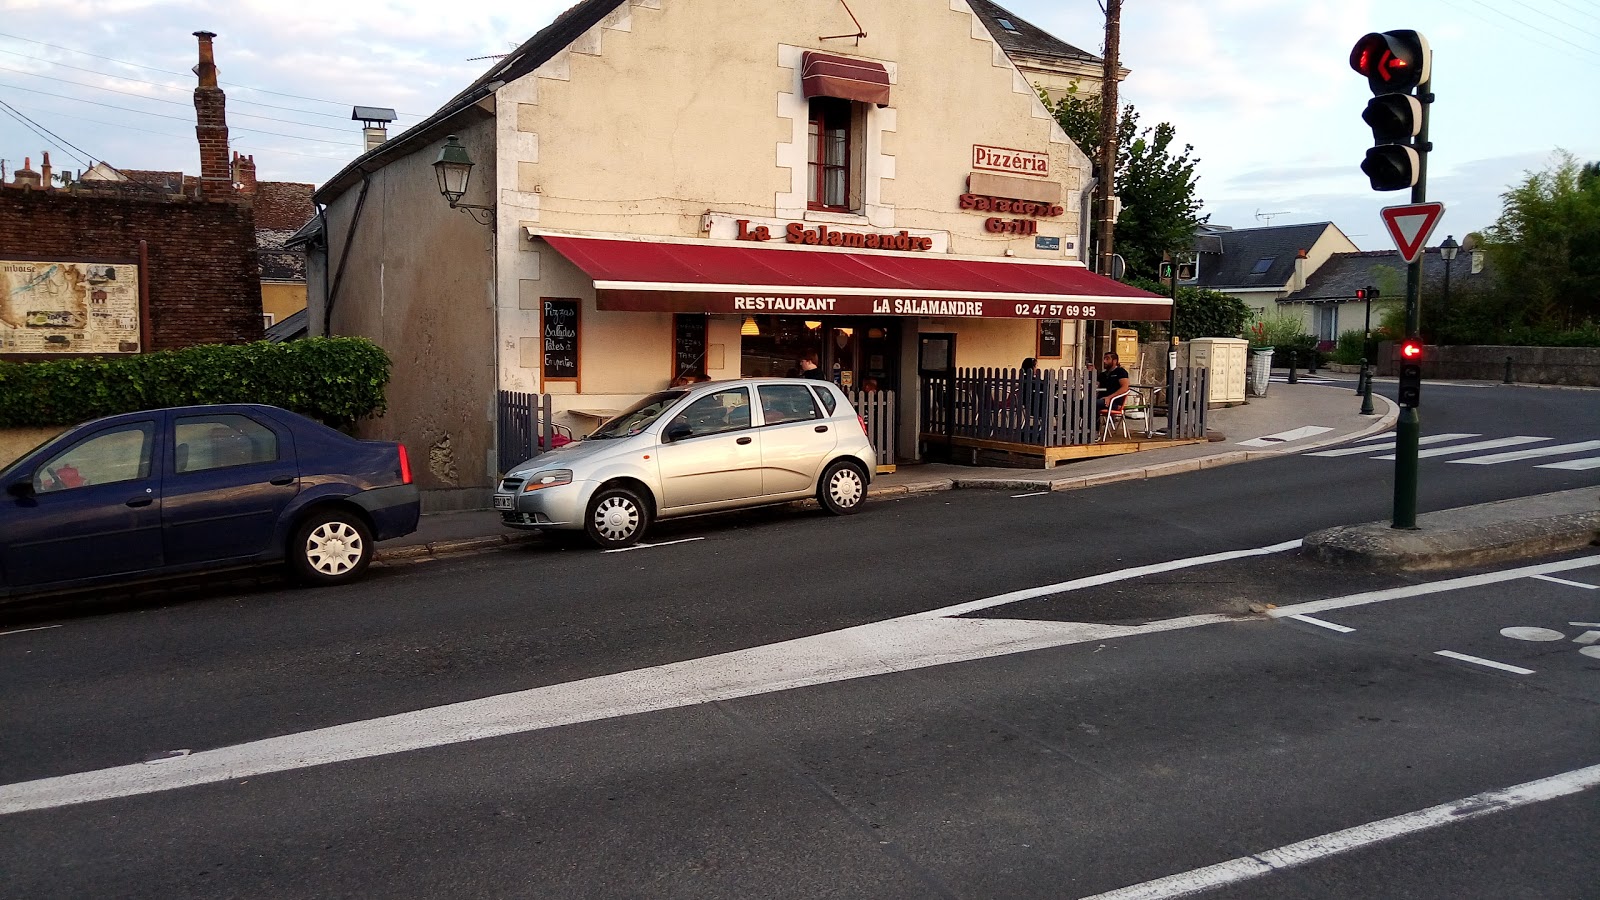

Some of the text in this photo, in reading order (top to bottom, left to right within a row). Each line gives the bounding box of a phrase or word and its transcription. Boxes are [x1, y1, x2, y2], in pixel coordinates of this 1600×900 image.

[976, 148, 1047, 172] Pizzéria
[985, 217, 1038, 235] Grill
[736, 219, 933, 251] La Salamandre
[734, 296, 836, 311] RESTAURANT
[873, 299, 983, 316] LA SALAMANDRE
[1015, 304, 1096, 317] 02 47 57 69 95
[544, 301, 575, 325] Pizzas
[544, 324, 576, 338] Salades
